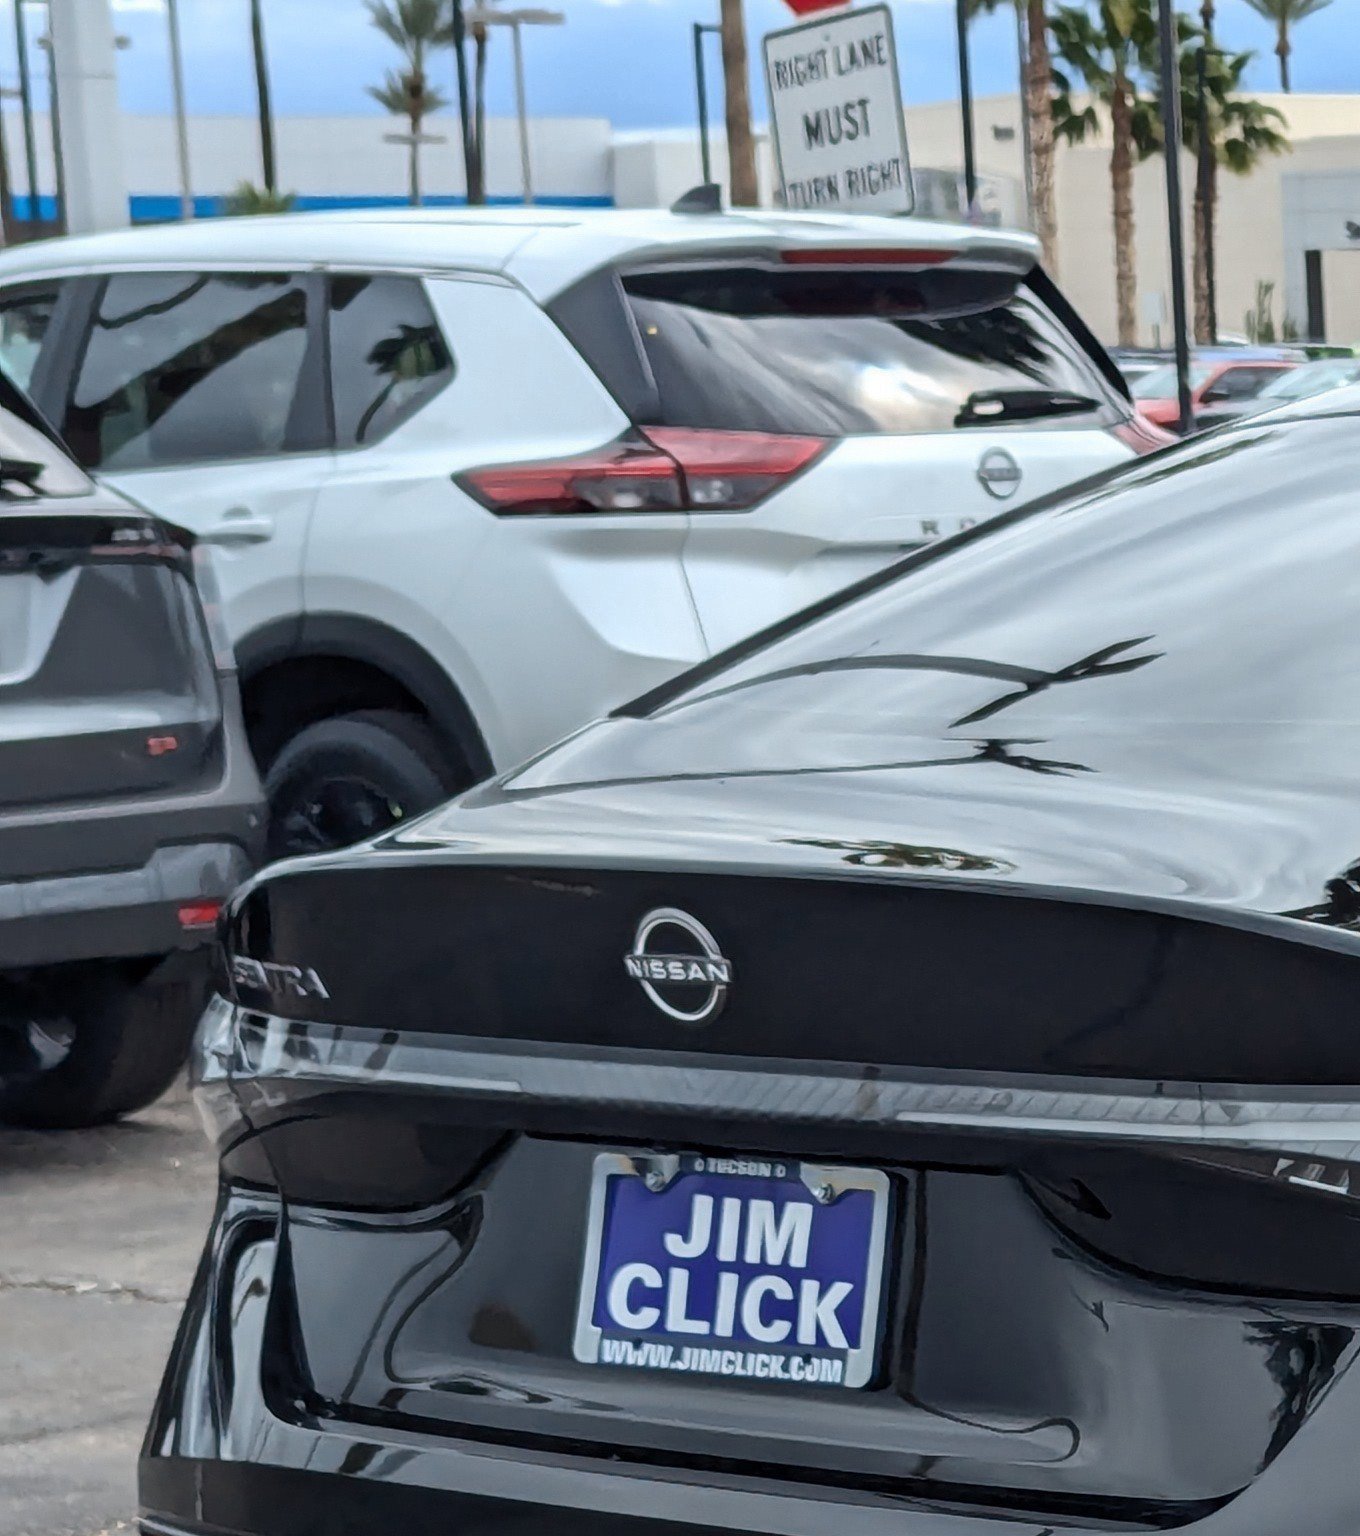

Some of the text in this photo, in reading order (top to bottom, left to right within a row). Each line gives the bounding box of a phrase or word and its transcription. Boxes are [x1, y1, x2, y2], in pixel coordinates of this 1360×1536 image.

[774, 34, 886, 91] RIGHT LANE
[802, 98, 870, 150] MUST
[788, 157, 900, 209] TURN RIGHT
[624, 957, 732, 983] NISSAN
[663, 1193, 814, 1269] JIM
[606, 1262, 854, 1350] CLICK
[602, 1337, 843, 1384] WWW.JIMCLICK.COM
